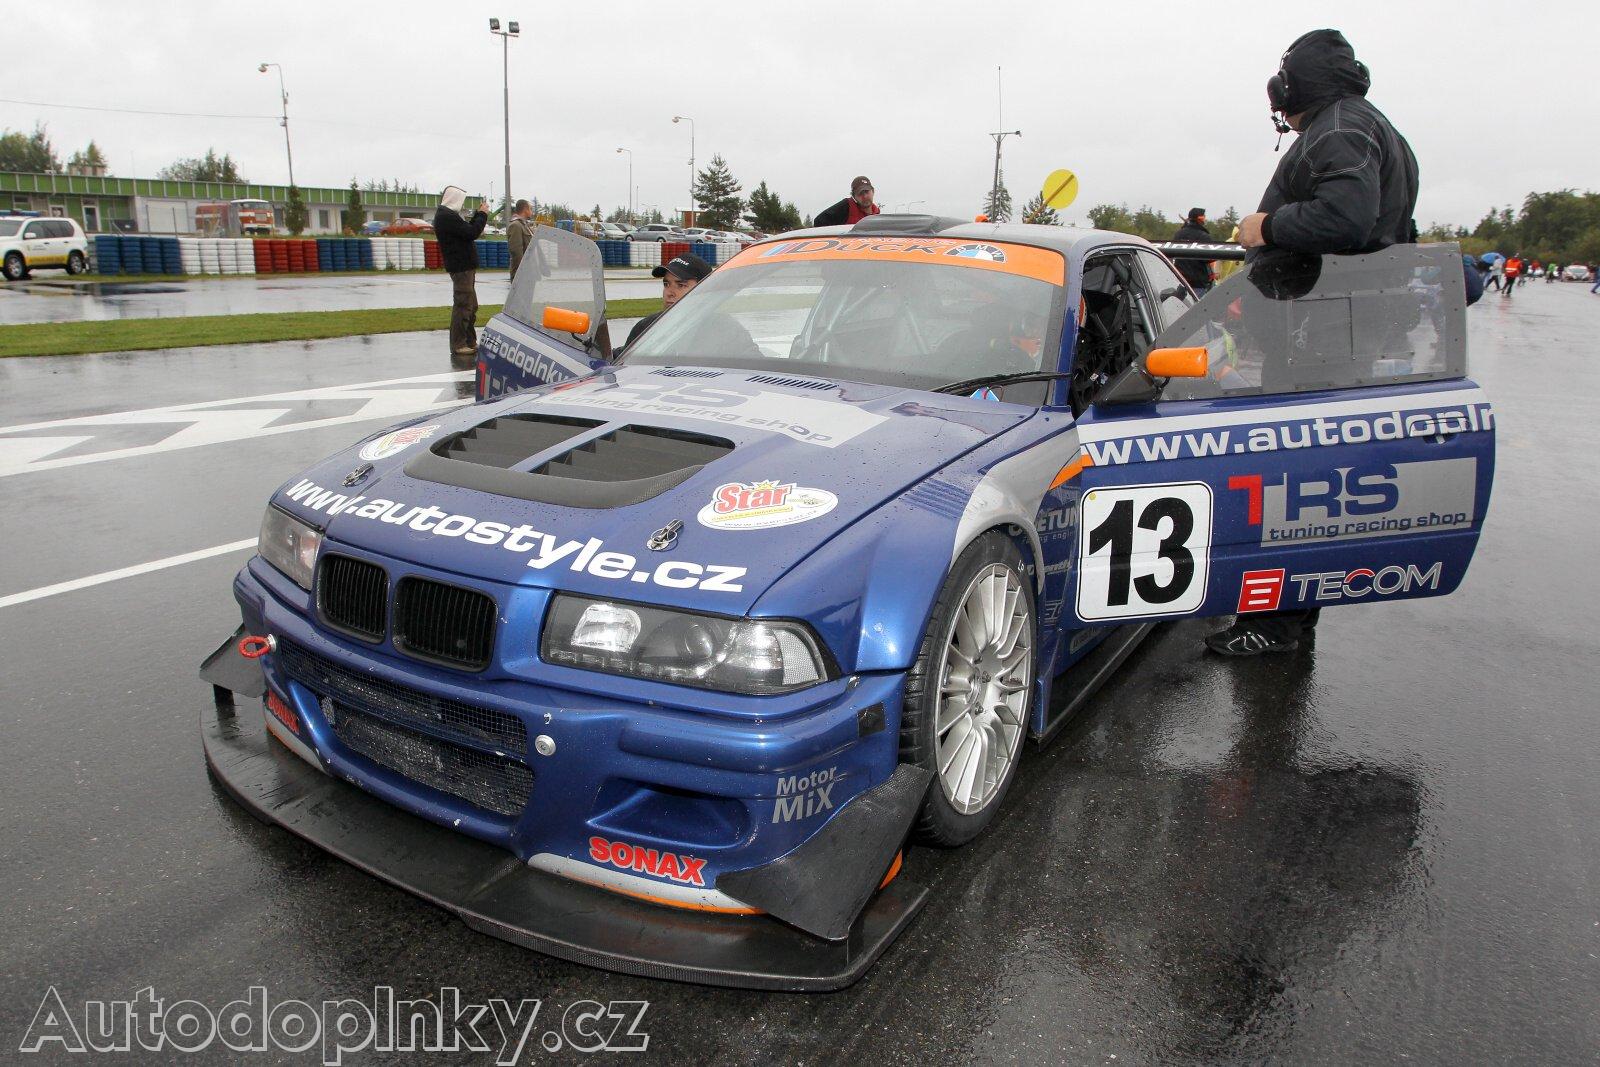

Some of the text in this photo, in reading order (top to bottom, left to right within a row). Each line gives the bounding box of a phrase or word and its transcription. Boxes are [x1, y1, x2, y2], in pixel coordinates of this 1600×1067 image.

[644, 403, 742, 422] racing
[746, 418, 833, 442] shop
[715, 484, 792, 513] Star
[285, 478, 747, 592] www.autostyle.cz
[1269, 511, 1466, 540] tuning racing shop
[1089, 497, 1195, 607] 13
[1290, 562, 1443, 601] TECOM
[777, 766, 837, 796] Motor
[772, 782, 835, 824] MiX
[589, 837, 707, 886] SONAX
